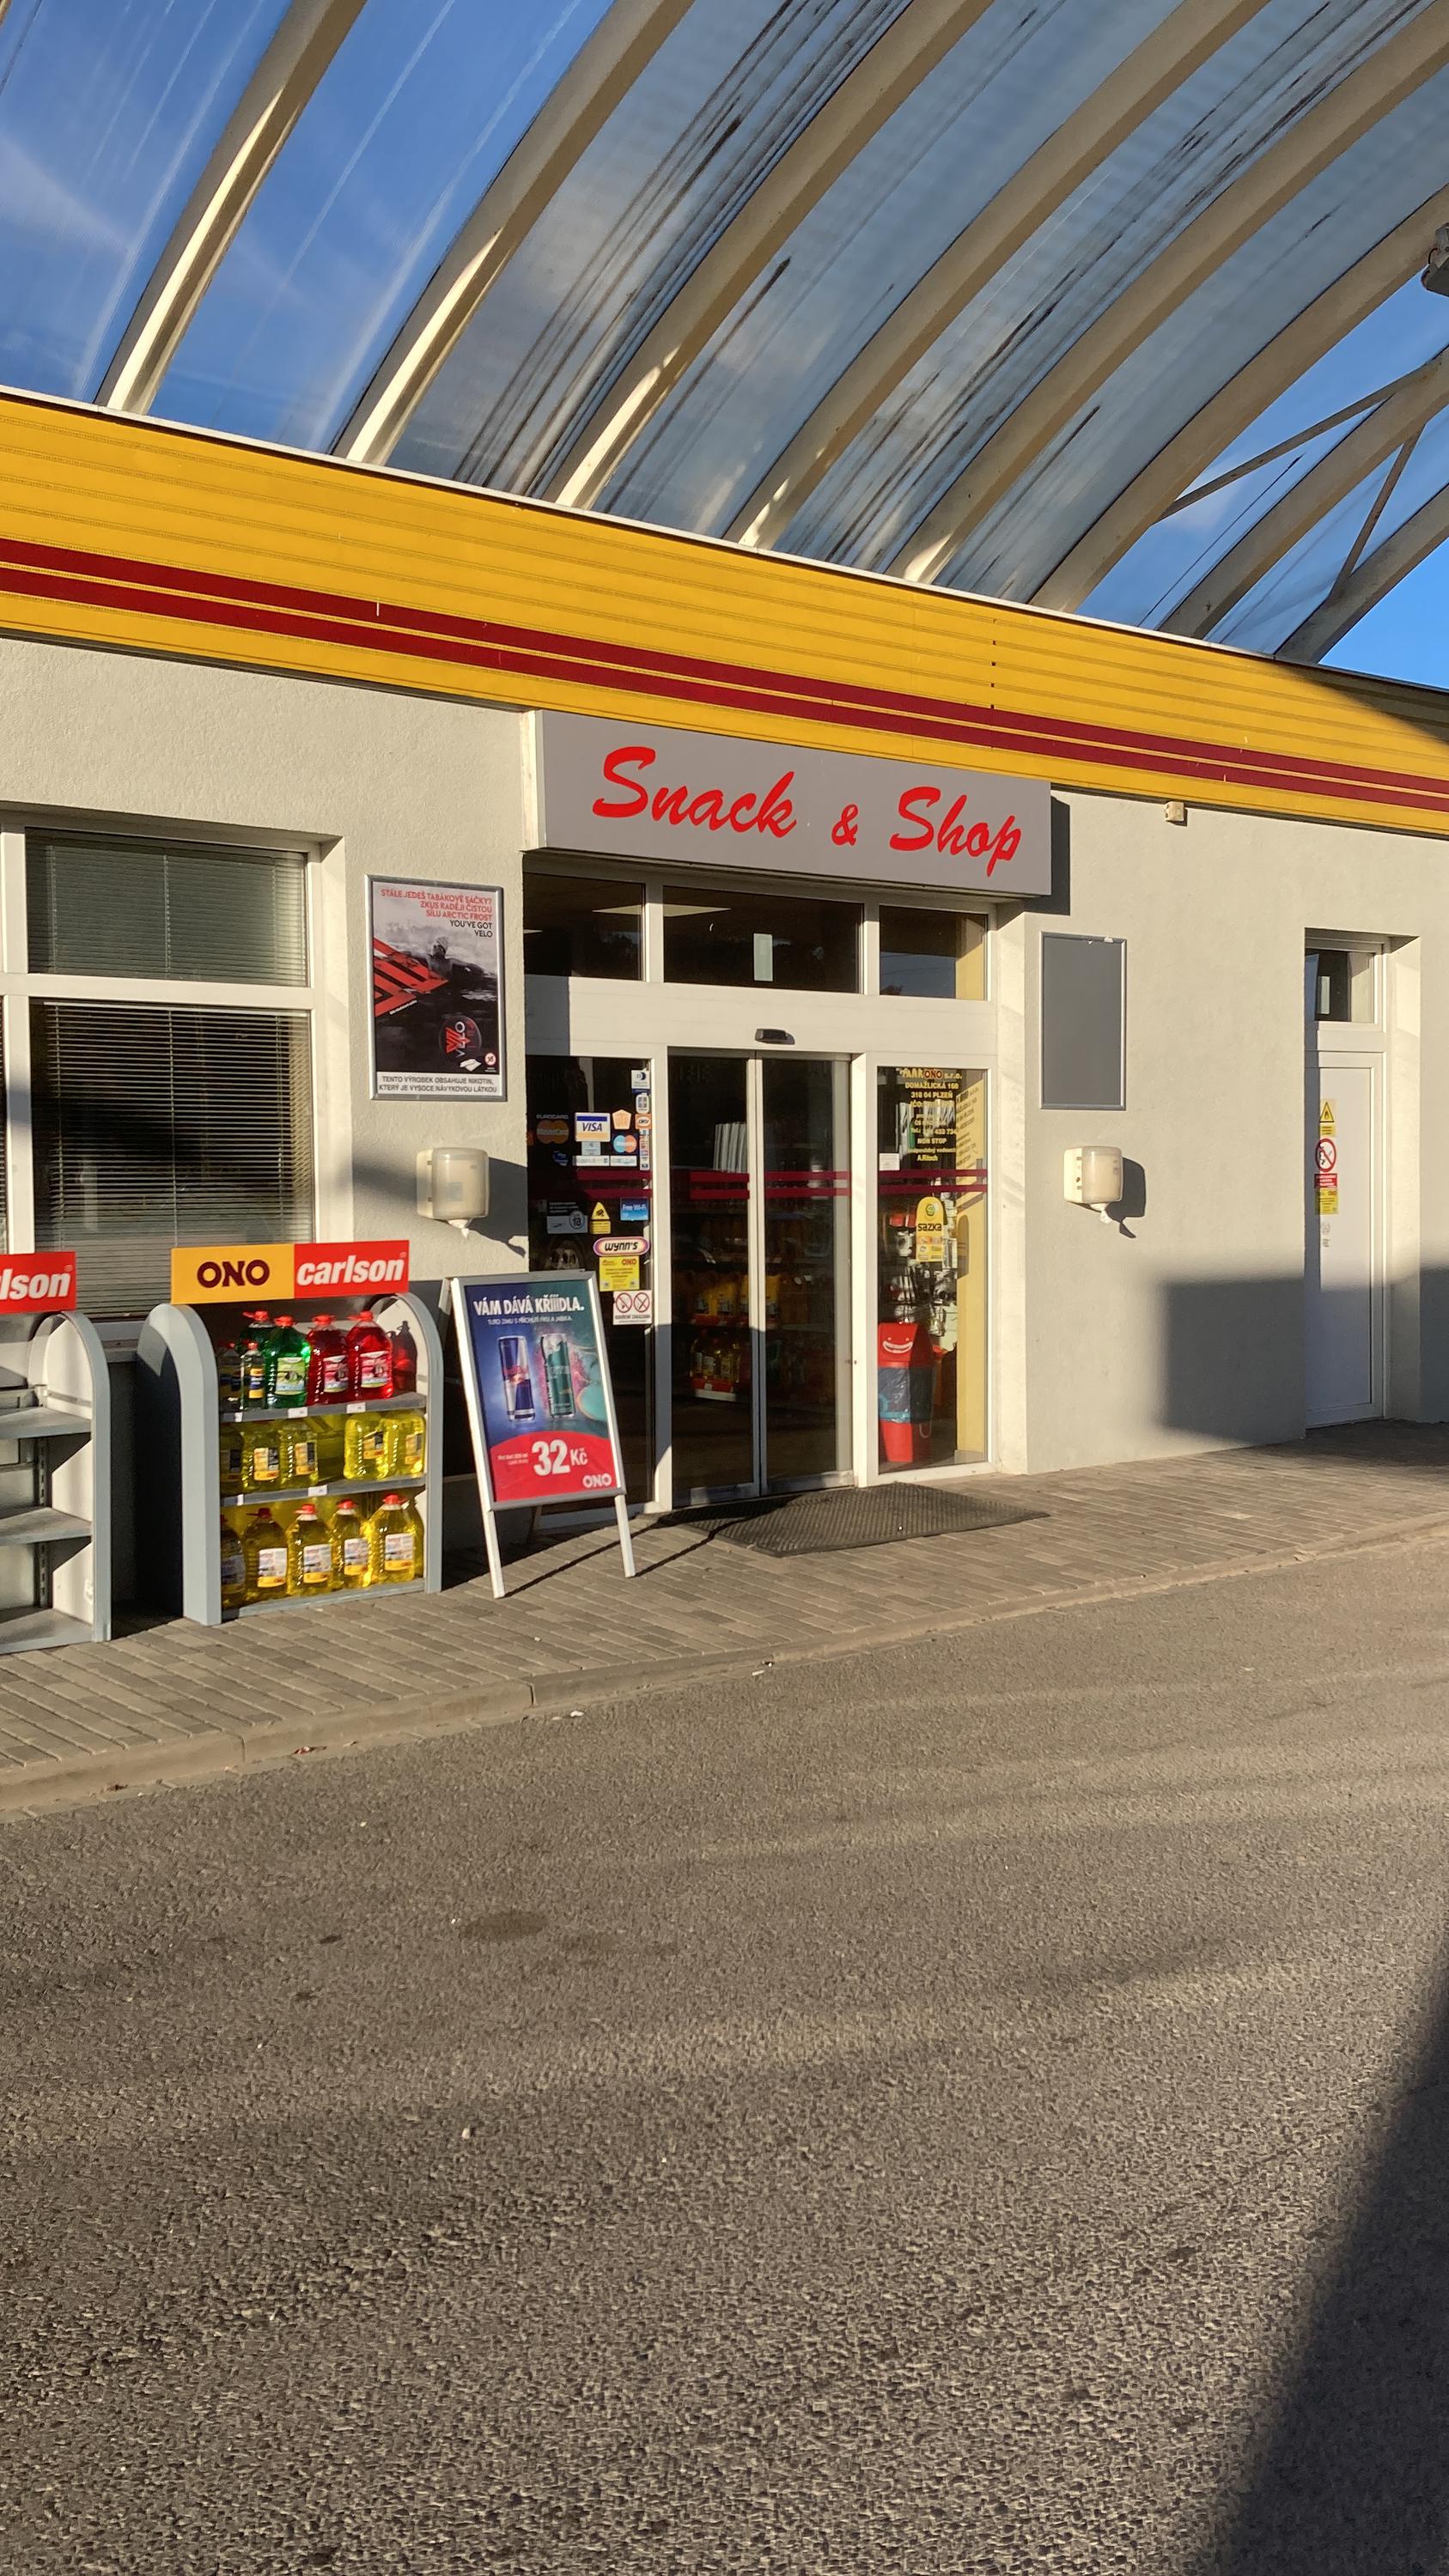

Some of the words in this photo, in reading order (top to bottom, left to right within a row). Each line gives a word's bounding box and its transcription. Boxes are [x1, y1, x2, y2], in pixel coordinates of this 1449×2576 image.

[593, 746, 797, 838] Snack
[831, 804, 859, 846] &
[889, 786, 1021, 877] Shop
[381, 889, 402, 898] STÁLE
[404, 890, 425, 900] JEDEŠ
[427, 892, 463, 903] TABÁKOVÉ
[465, 895, 492, 905] SÁČKY?
[420, 901, 439, 909] ZKUS
[441, 902, 464, 910] RADĚJI
[466, 903, 492, 913] ČISTOU
[426, 908, 441, 917] SÍLU
[470, 913, 492, 921] FROST
[474, 929, 493, 938] VELO
[905, 1081, 946, 1090] DOMAŽLICKÁ
[582, 1122, 603, 1132] VISA
[621, 1258, 637, 1267] ONO
[197, 1259, 270, 1289] ONO
[296, 1255, 405, 1286] carlson
[0, 1269, 72, 1301] lson
[473, 1297, 502, 1316] VÁM
[503, 1294, 533, 1315] DÁVÁ
[532, 1439, 570, 1476] 32
[569, 1448, 588, 1466] Kč
[582, 1473, 612, 1488] ONO
